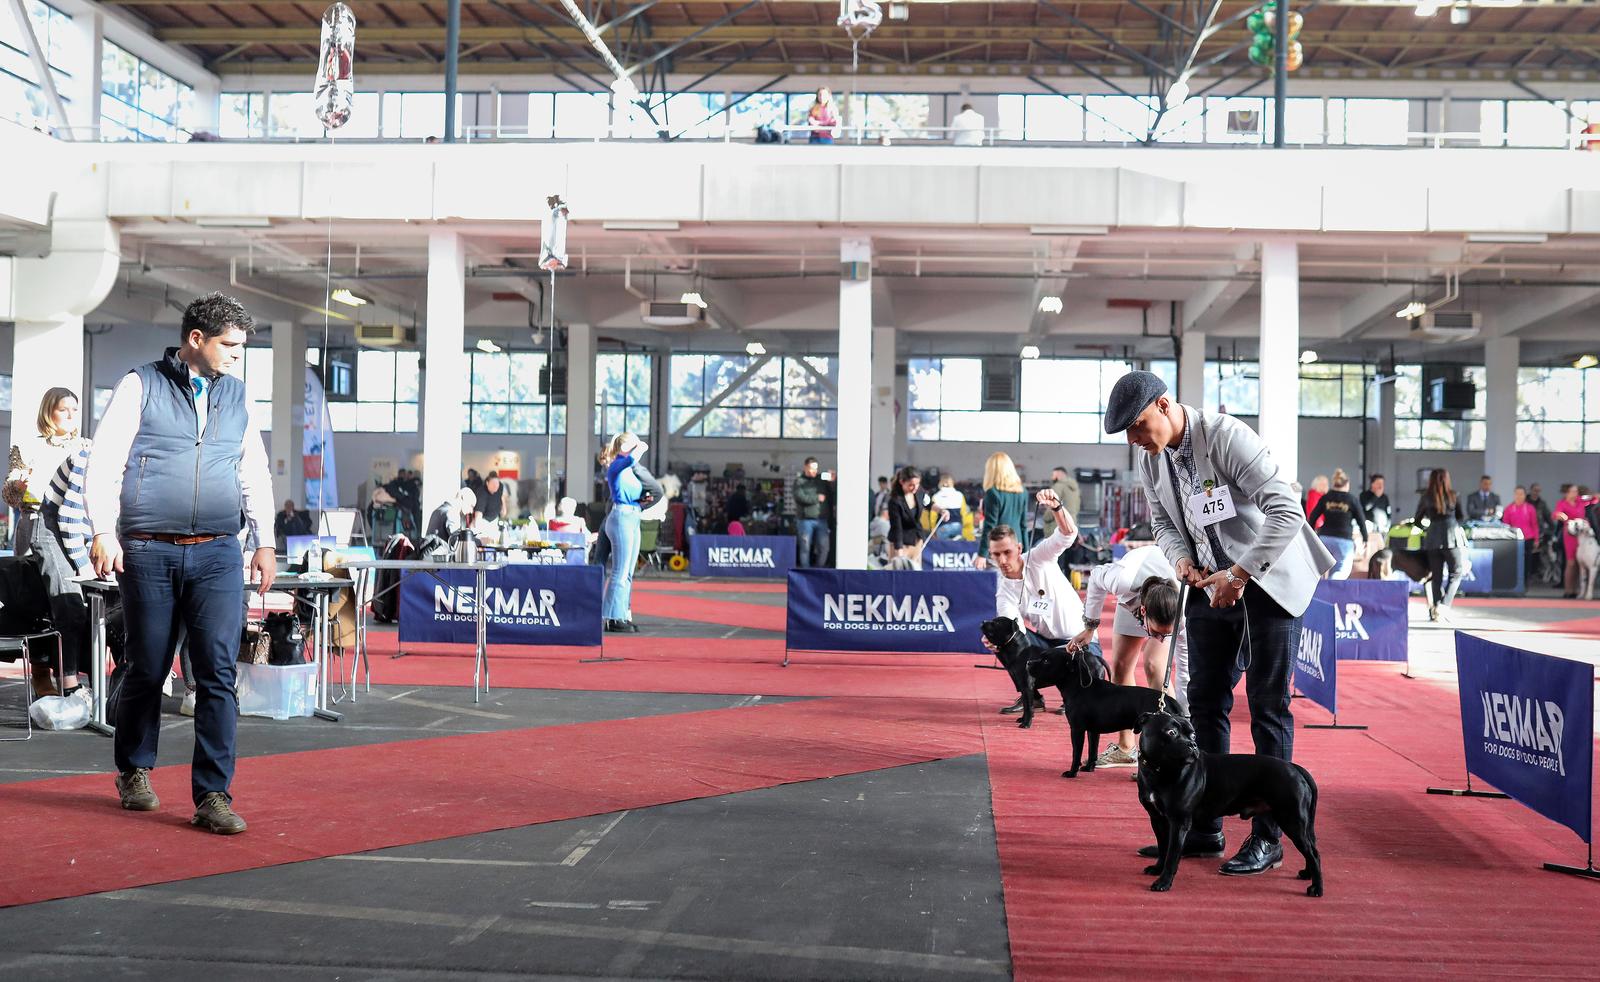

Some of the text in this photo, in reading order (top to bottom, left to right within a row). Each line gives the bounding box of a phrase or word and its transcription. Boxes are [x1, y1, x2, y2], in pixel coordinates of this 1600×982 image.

[1202, 498, 1225, 515] 475
[708, 547, 775, 568] NEKMAR
[933, 552, 978, 568] NEKM
[434, 585, 560, 626] NEKMAR
[824, 594, 955, 632] NEKMAR
[1033, 601, 1048, 610] 472
[434, 613, 452, 621] FOR
[454, 614, 477, 622] DOGS
[516, 617, 550, 625] PEOPLE
[1335, 631, 1358, 639] OPLE
[1297, 627, 1325, 682] EKMAR
[1480, 690, 1565, 776] NEKMAR
[1484, 742, 1498, 754] FOR
[1499, 745, 1515, 759] DOGS
[1539, 755, 1558, 772] PEOPLE
